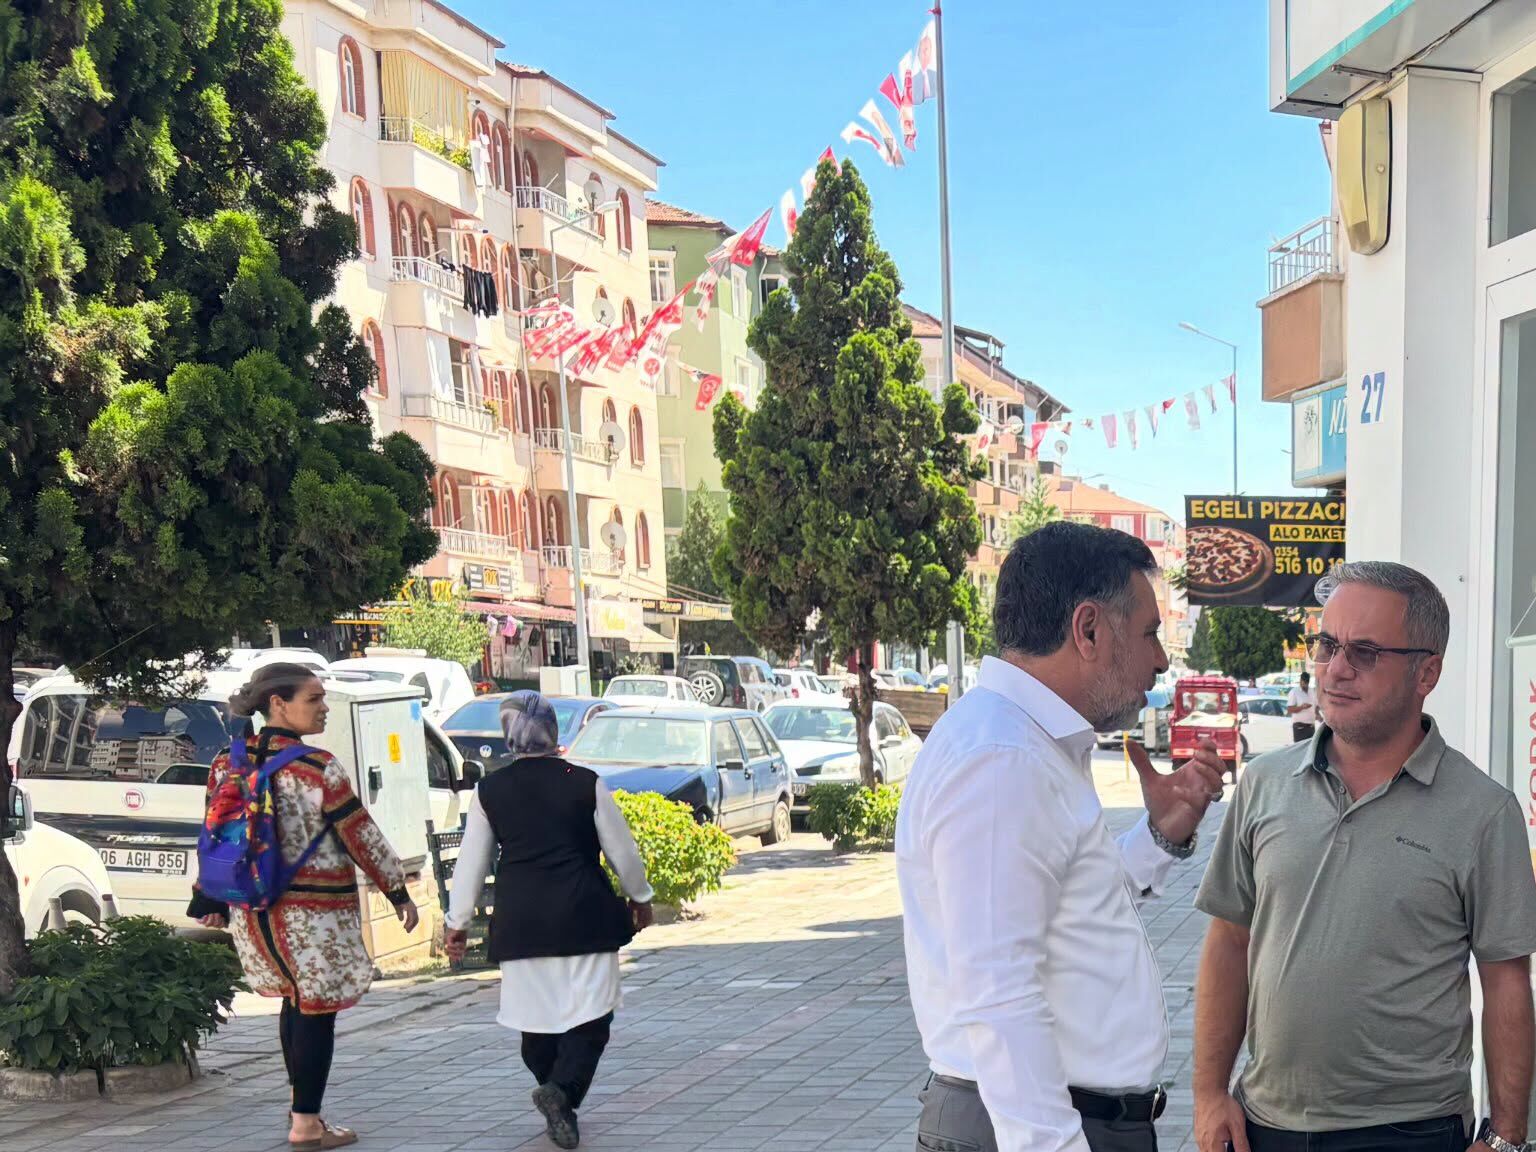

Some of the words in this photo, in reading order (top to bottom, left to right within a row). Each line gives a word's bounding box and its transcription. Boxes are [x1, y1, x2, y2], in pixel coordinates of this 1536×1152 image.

[1360, 371, 1385, 424] 27
[1273, 527, 1300, 540] ALO
[1304, 528, 1346, 541] PAKET
[1274, 547, 1299, 558] 0354
[1275, 558, 1301, 575] 516
[1305, 558, 1324, 575] 10
[101, 850, 117, 866] 06
[126, 851, 151, 868] AGH
[158, 853, 183, 869] 856
